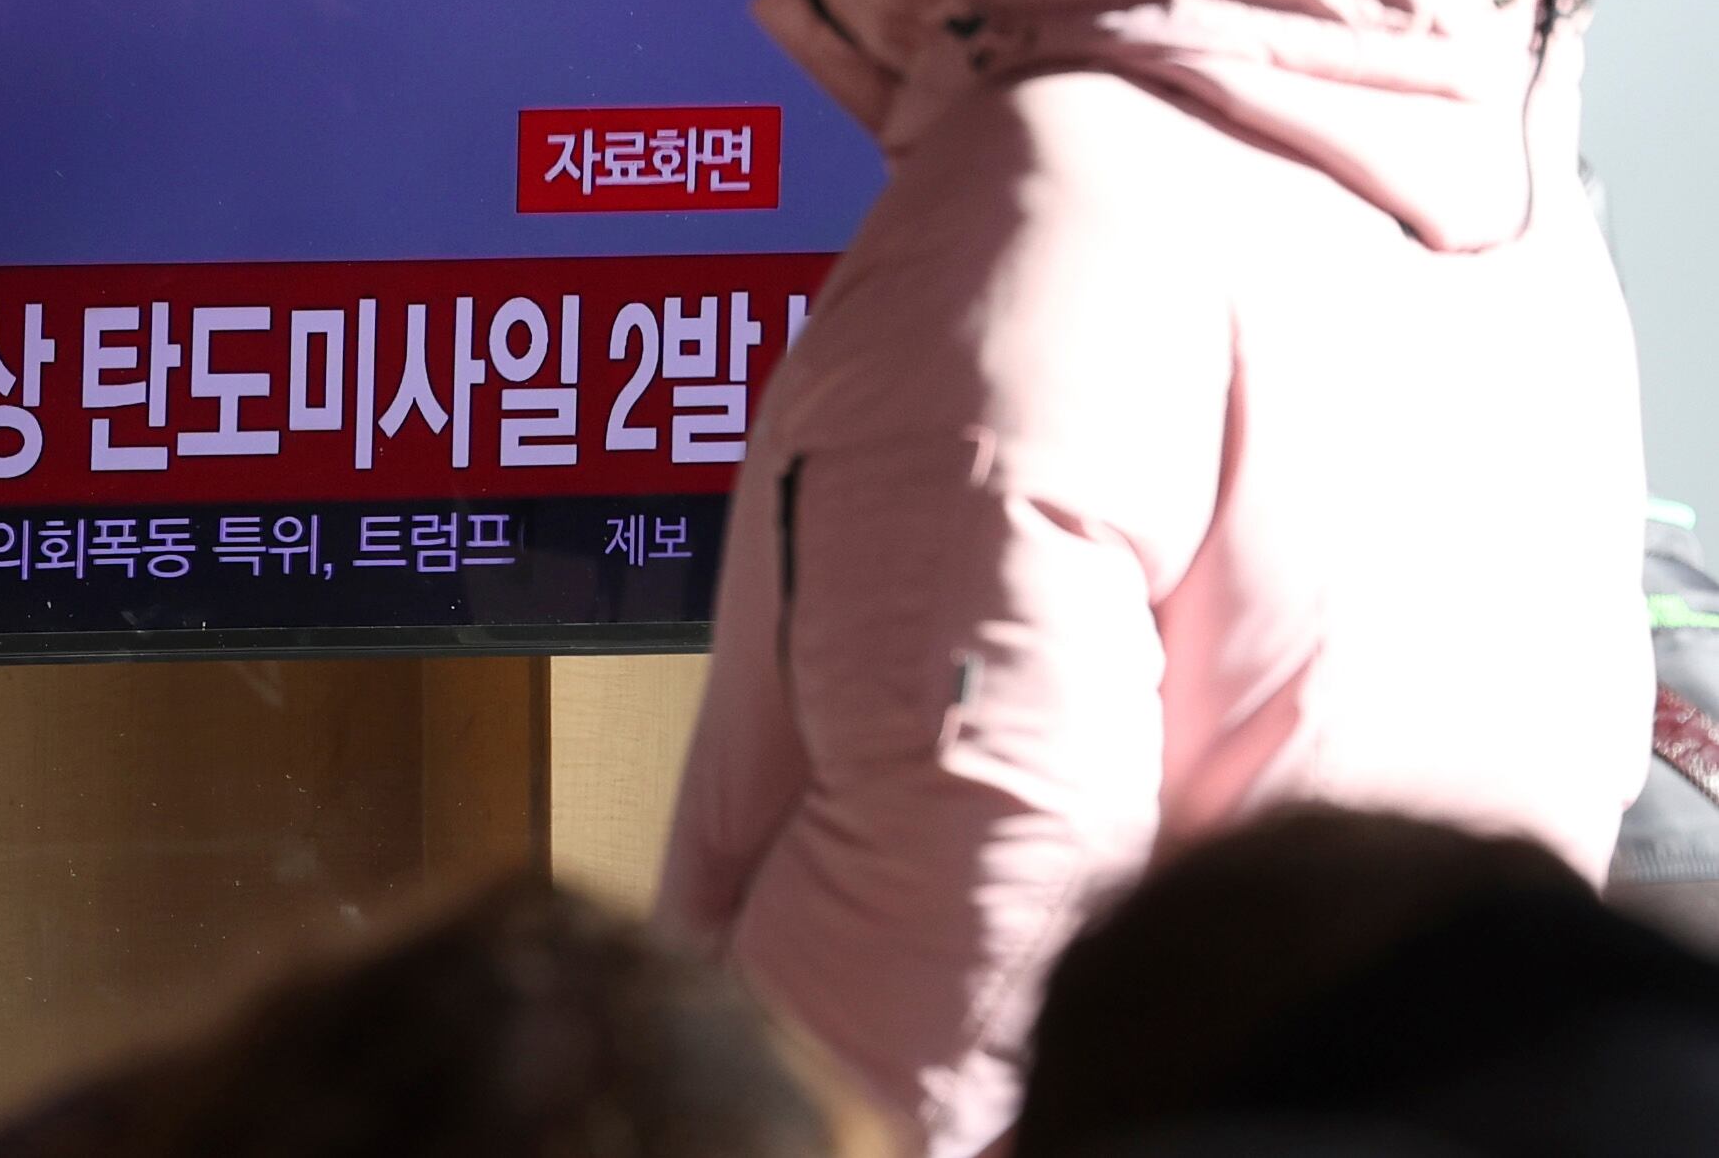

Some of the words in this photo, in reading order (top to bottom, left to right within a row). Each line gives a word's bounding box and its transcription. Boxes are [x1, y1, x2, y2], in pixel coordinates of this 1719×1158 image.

[544, 125, 752, 196] 자료화면
[81, 294, 581, 472] 탄도미사일
[605, 291, 762, 464] 2발
[211, 514, 334, 581] 특위,
[352, 511, 517, 574] 트럼프
[604, 514, 693, 567] 제보
